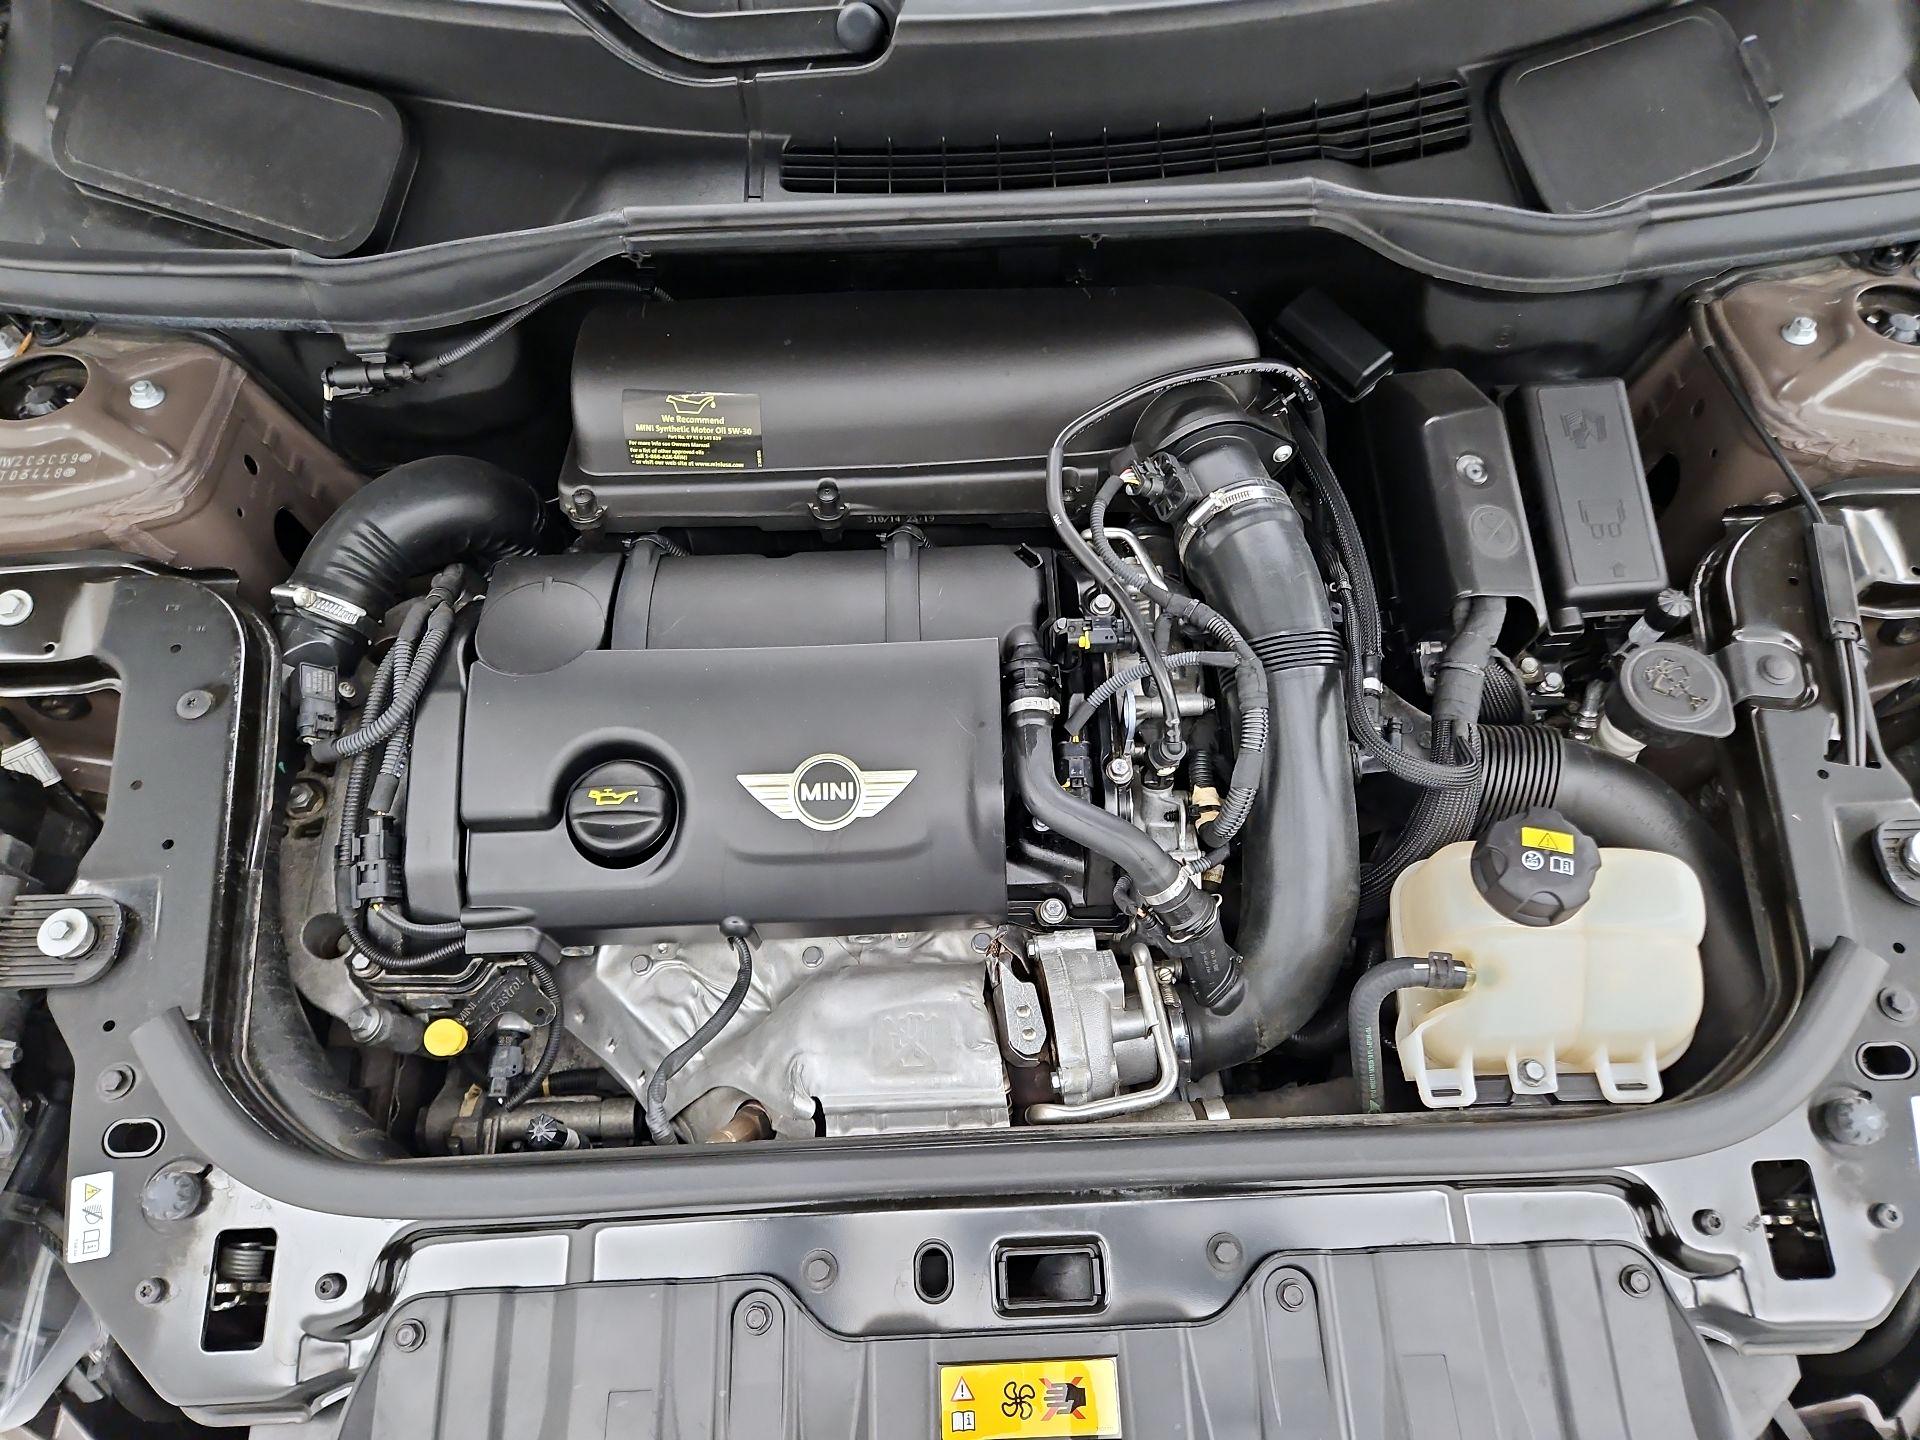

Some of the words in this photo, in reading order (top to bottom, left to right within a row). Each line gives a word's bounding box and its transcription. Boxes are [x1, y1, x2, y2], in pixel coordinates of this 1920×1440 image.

[636, 424, 654, 432] MINI
[656, 425, 689, 434] Synthetic
[691, 426, 714, 434] Motor
[715, 426, 726, 434] Oil
[728, 427, 752, 435] 5W-30
[662, 415, 674, 423] We
[676, 415, 724, 425] Recommend
[800, 781, 854, 801] MINI
[490, 977, 525, 1014] Castrol
[457, 1001, 477, 1023] MINI
